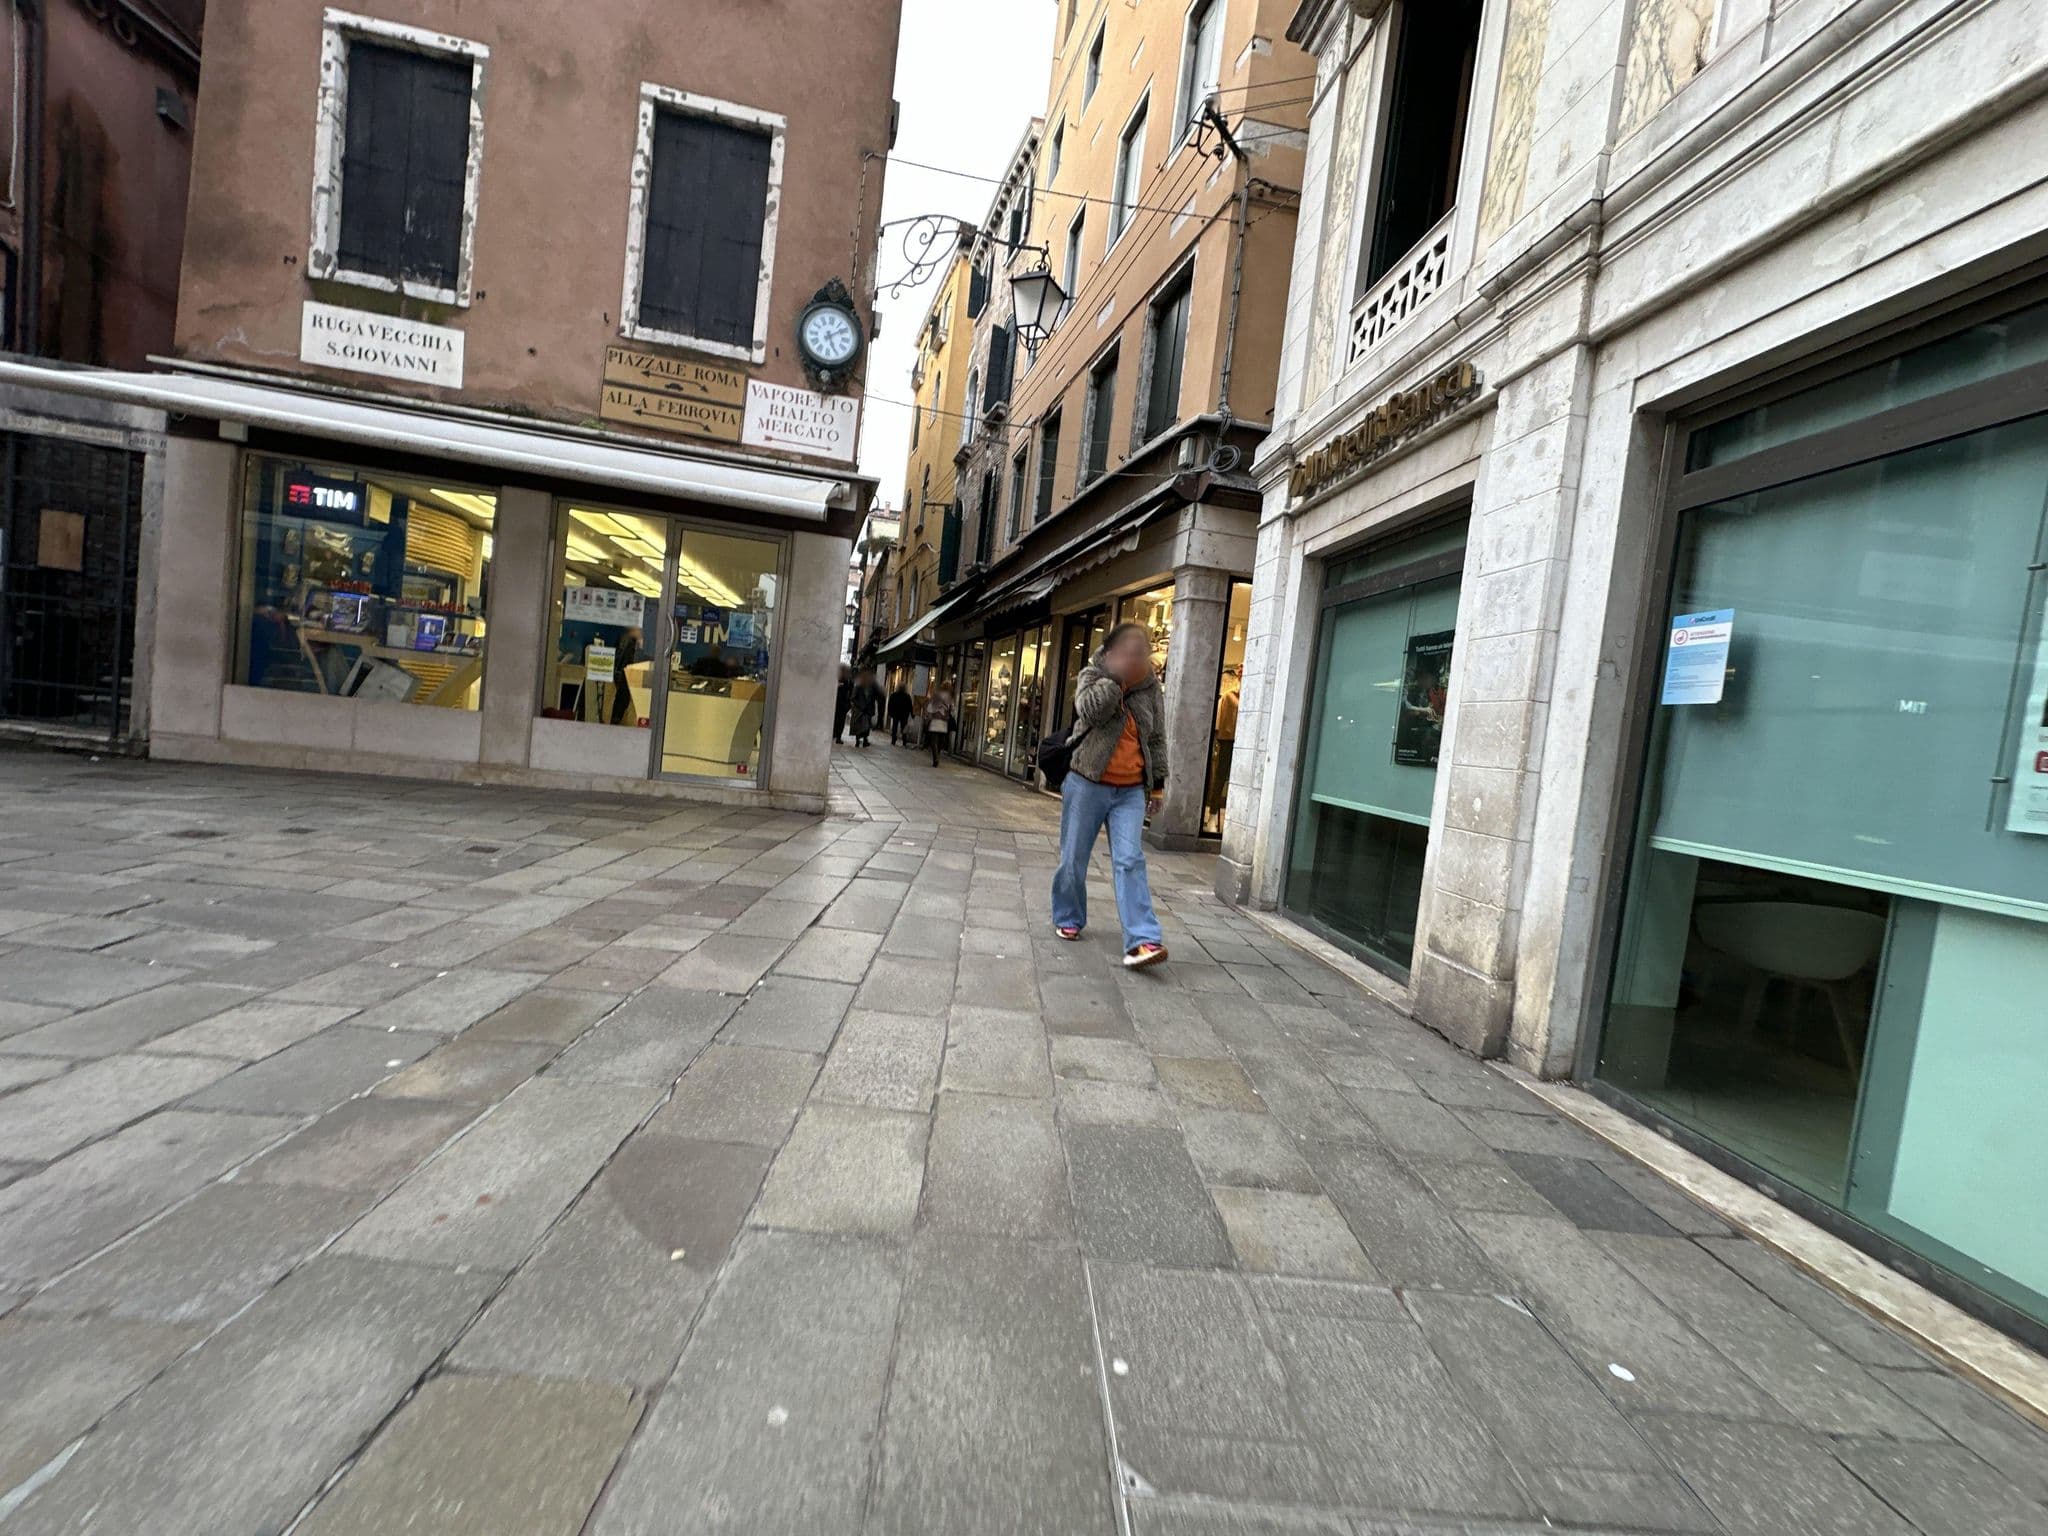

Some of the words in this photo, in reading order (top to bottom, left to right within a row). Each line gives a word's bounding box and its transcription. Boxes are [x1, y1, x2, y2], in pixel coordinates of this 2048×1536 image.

[312, 314, 363, 336] RUGA
[369, 324, 453, 352] VECCHIA
[609, 350, 687, 377] PIAZZALE
[694, 367, 738, 388] ROMA
[606, 391, 647, 409] ALLA
[658, 399, 736, 425] FERROVIA
[752, 384, 853, 414] VAPORETTO
[1387, 362, 1475, 435] Banca
[758, 417, 840, 443] MERCATO
[769, 404, 834, 426] RIALTO
[313, 487, 355, 511] TIM
